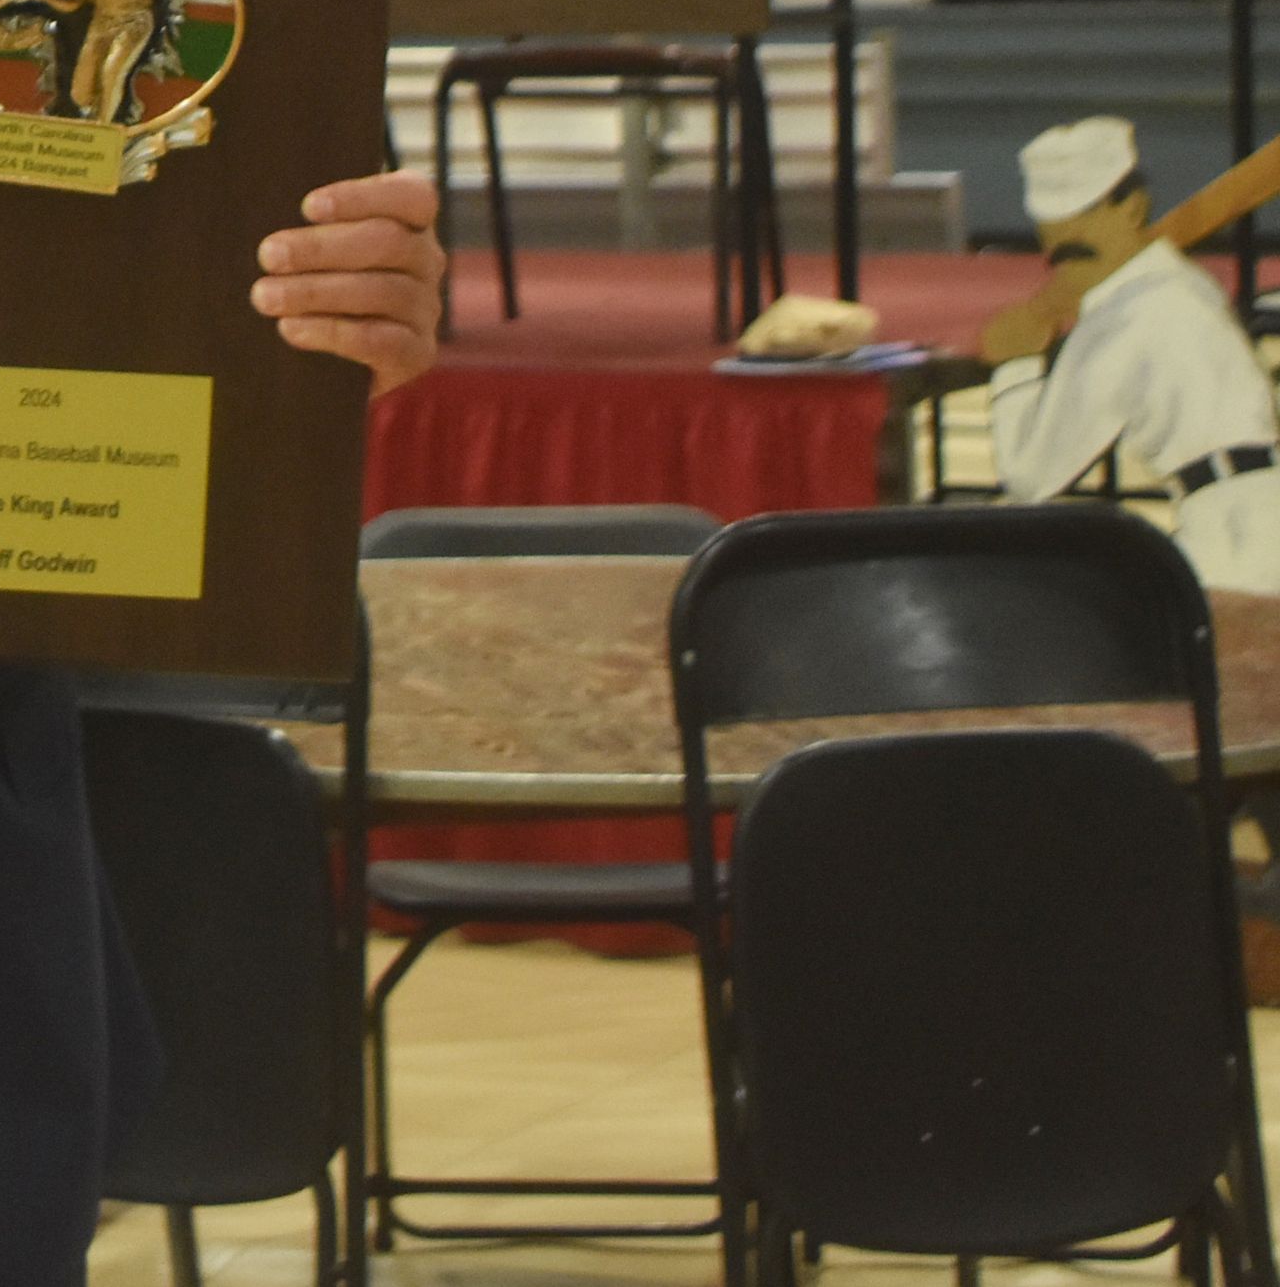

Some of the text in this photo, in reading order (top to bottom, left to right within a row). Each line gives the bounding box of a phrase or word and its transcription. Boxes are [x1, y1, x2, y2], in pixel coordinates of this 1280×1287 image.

[28, 123, 95, 144] Carolina
[38, 140, 105, 162] Museum
[22, 158, 89, 179] Banquet
[18, 387, 63, 408] 2024
[26, 441, 101, 464] Baseball
[105, 446, 180, 468] Museum
[10, 494, 55, 521] King
[59, 497, 121, 519] Award
[17, 550, 98, 575] Godwin
